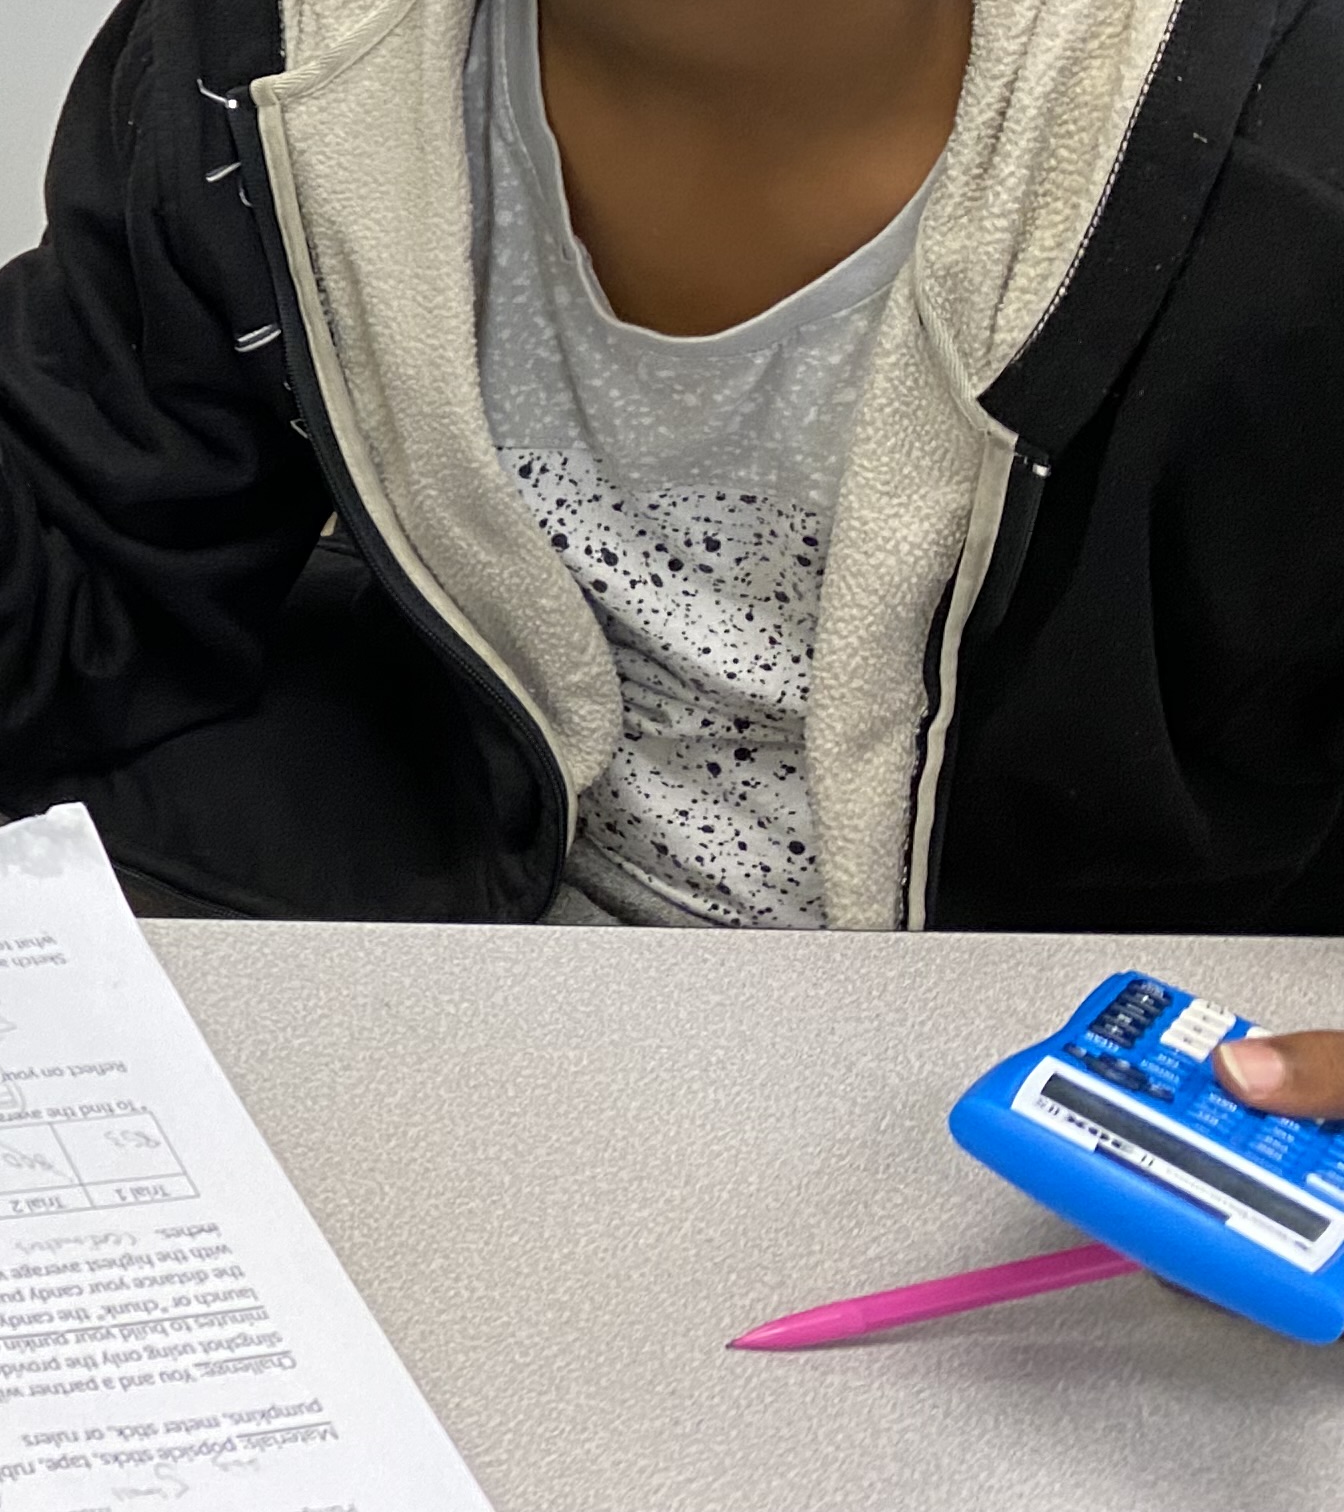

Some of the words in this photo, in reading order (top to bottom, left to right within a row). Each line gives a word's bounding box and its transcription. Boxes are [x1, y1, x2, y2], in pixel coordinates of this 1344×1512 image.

[12, 935, 56, 952] what
[12, 952, 67, 971] Sketch
[1, 1064, 41, 1083] your
[68, 1061, 127, 1079] Reflect
[46, 1106, 75, 1122] the
[79, 1102, 113, 1120] find
[114, 1188, 125, 1203] 1
[127, 1183, 169, 1202] Trial
[10, 1200, 23, 1215] 2
[26, 1195, 63, 1213] Trial
[86, 1251, 153, 1274] highest
[156, 1249, 189, 1266] the
[191, 1244, 232, 1263] with
[11, 1262, 82, 1280] average
[132, 1269, 210, 1289] distance
[212, 1265, 244, 1282] the
[29, 1284, 84, 1303] candy
[87, 1274, 129, 1294] your
[195, 1287, 259, 1310] launch
[56, 1307, 91, 1324] the
[198, 1311, 270, 1329] minutes
[4, 1329, 69, 1354] punkin
[74, 1324, 114, 1344] your
[119, 1323, 165, 1343] build
[147, 1343, 197, 1359] using
[199, 1332, 284, 1355] slingshot
[64, 1354, 98, 1371] the
[101, 1348, 143, 1367] only
[199, 1354, 298, 1378] Challenge:
[28, 1374, 99, 1397] partner
[119, 1372, 156, 1391] and
[158, 1368, 194, 1384] You
[222, 1398, 324, 1425] pumpkins,
[163, 1414, 221, 1431] meter
[22, 1430, 80, 1448] rulers
[158, 1435, 237, 1462] popsicle
[242, 1427, 339, 1451] Materials:
[37, 1454, 92, 1472] tape,
